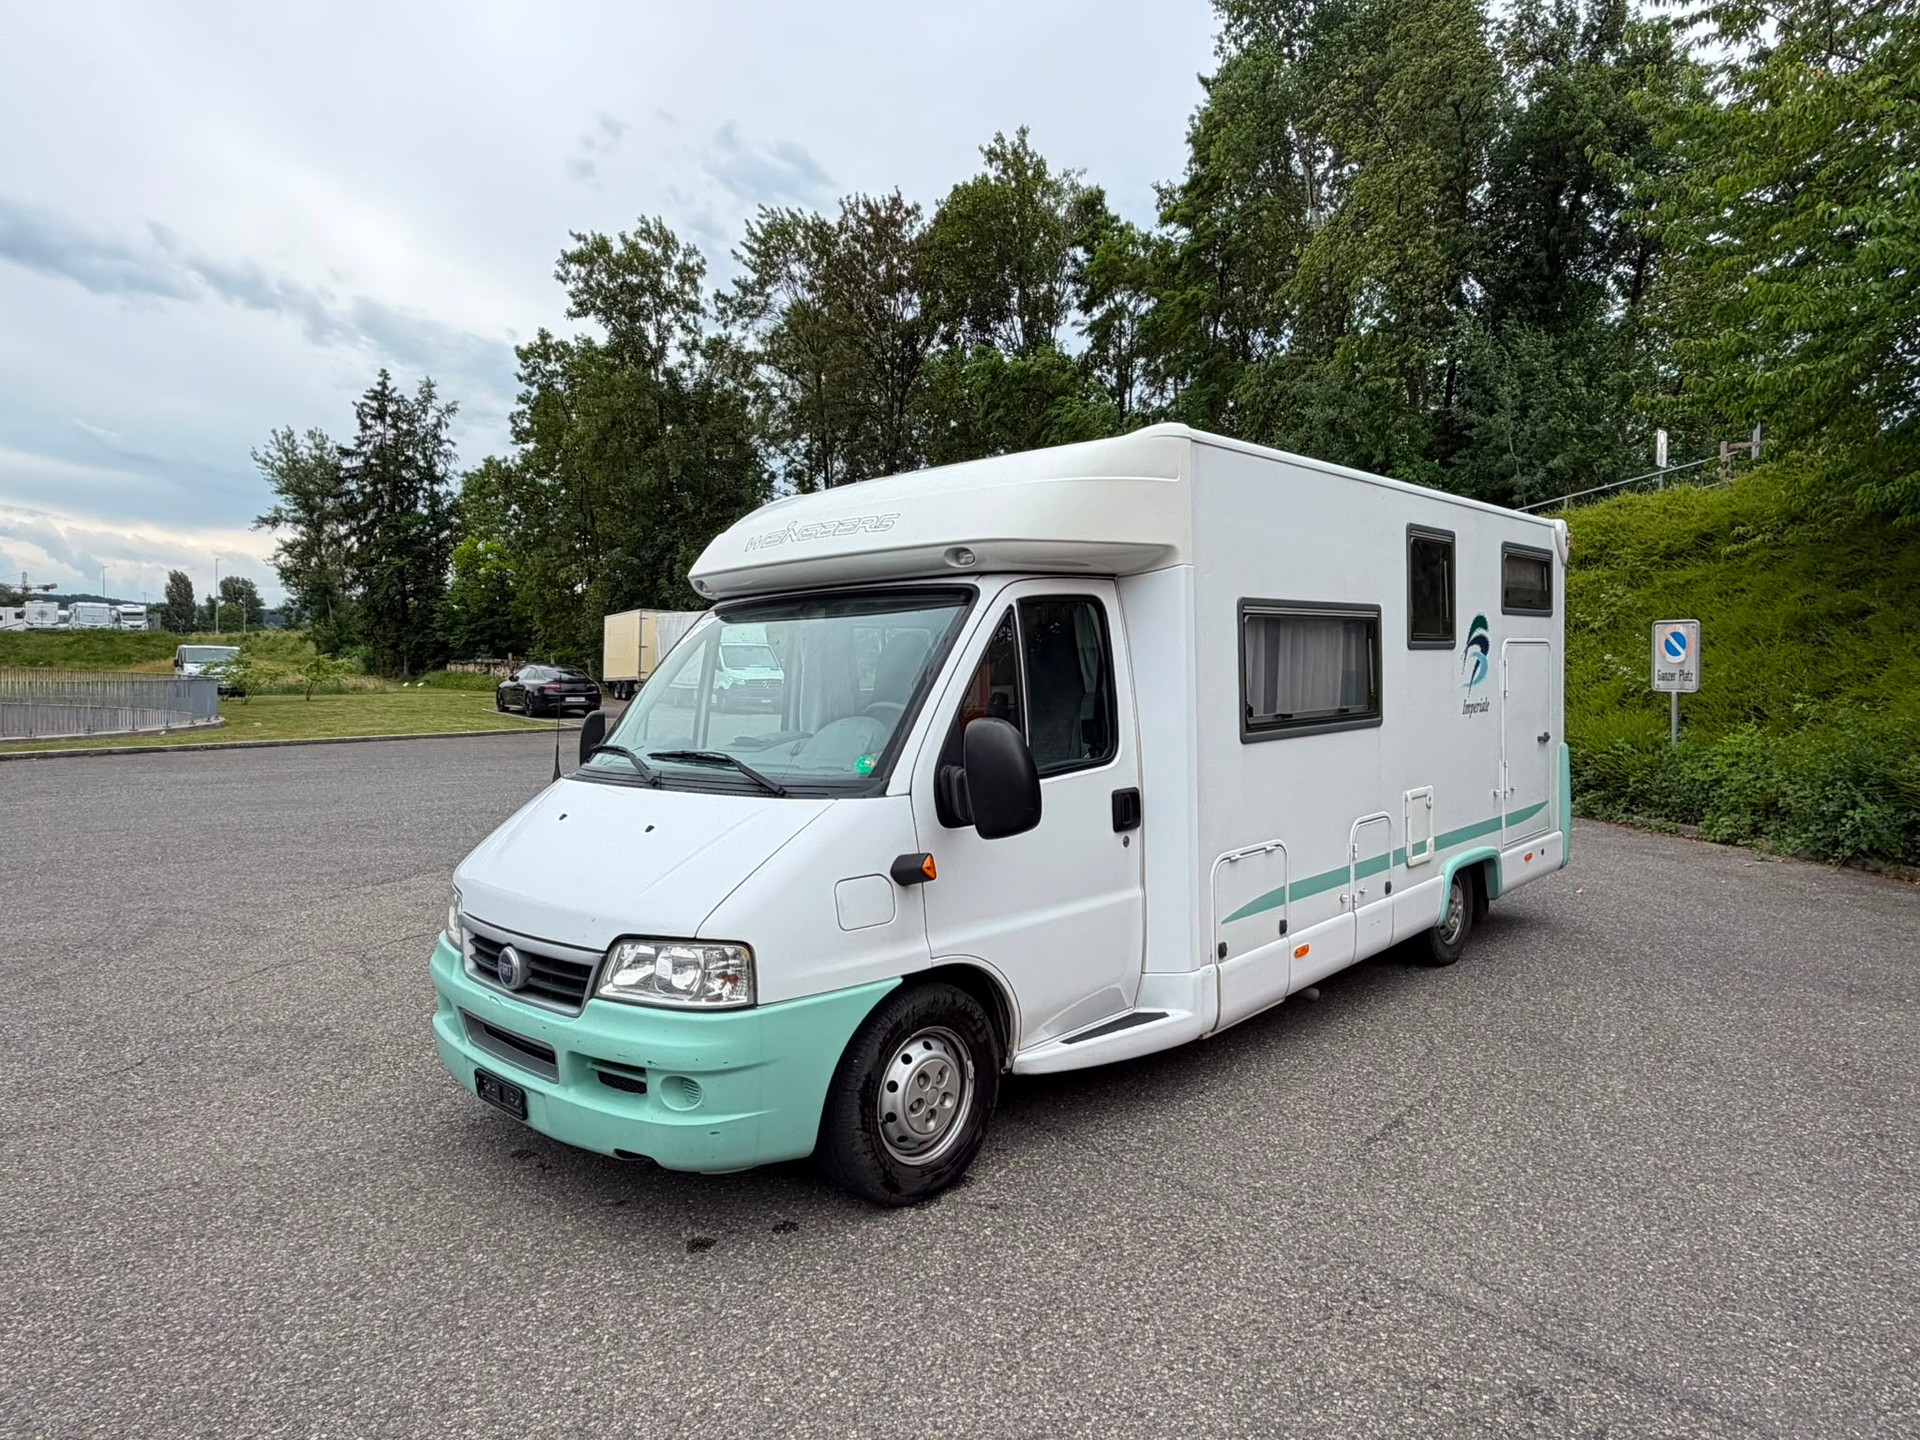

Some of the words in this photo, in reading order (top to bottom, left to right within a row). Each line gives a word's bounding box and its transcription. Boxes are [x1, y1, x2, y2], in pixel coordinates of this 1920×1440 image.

[1657, 669, 1677, 682] Ganzer
[1679, 669, 1694, 682] Platz
[1462, 697, 1490, 719] Imperiale
[500, 961, 512, 977] FIAT
